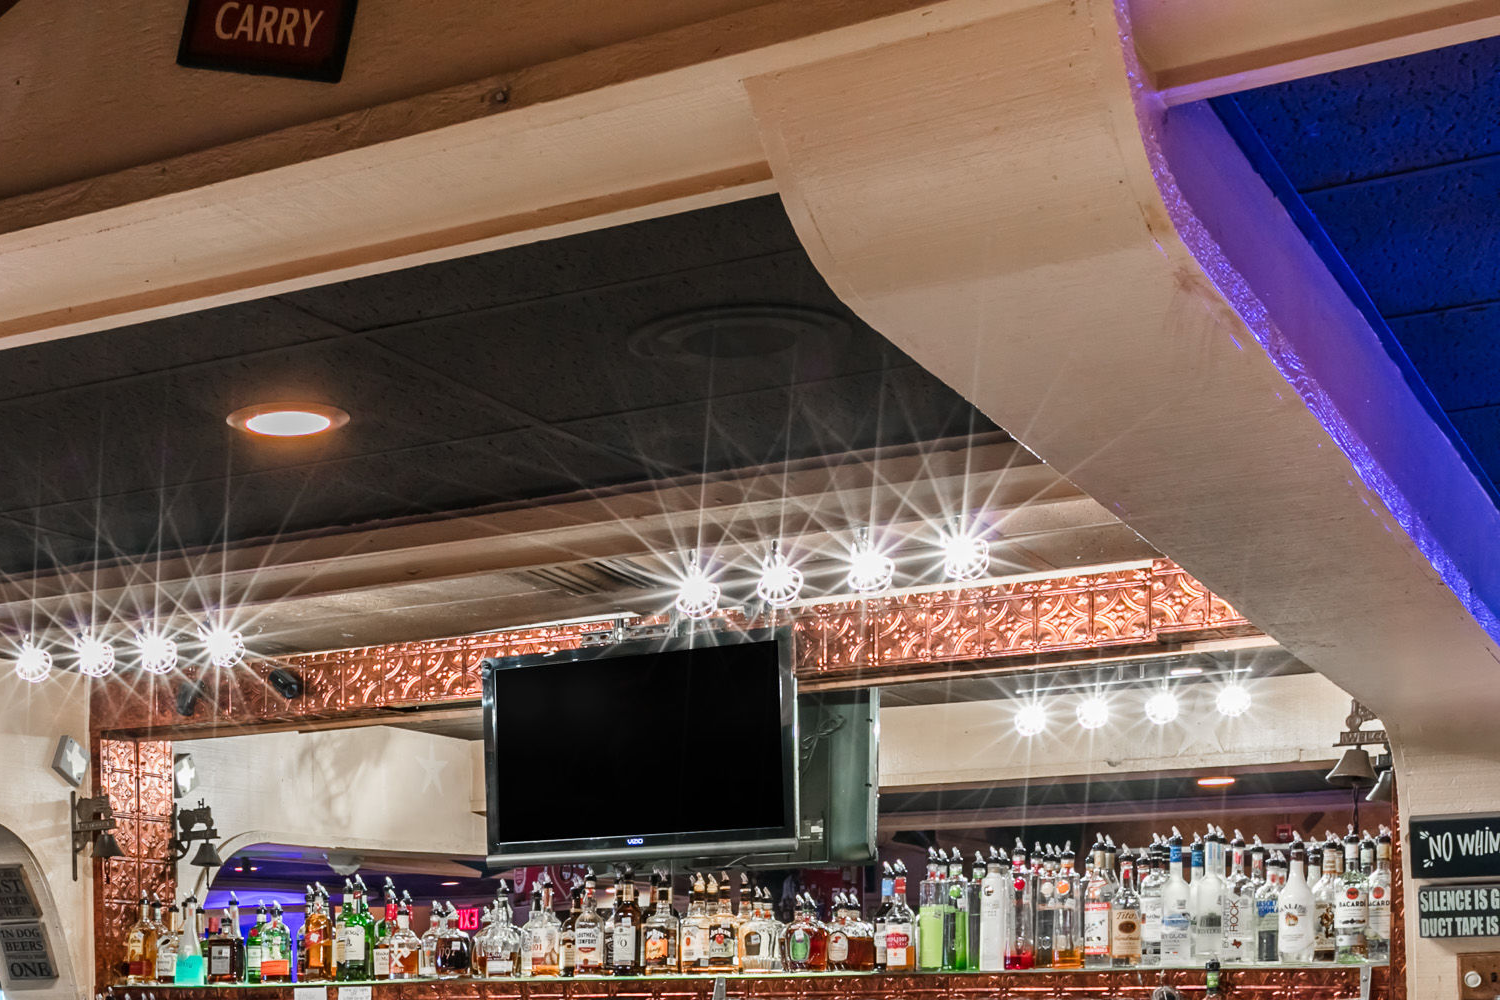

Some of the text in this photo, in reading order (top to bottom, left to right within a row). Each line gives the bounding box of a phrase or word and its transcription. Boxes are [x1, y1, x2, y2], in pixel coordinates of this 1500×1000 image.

[214, 1, 324, 48] CARRY
[1428, 831, 1453, 861] NO
[1420, 889, 1472, 912] SILENCE
[1474, 889, 1488, 911] IS
[1230, 899, 1240, 932] ROCK
[1421, 915, 1499, 937] DUCT TAPE IS
[1, 928, 40, 939] IN DOG
[5, 941, 44, 952] BEERS
[10, 961, 51, 978] ONE
